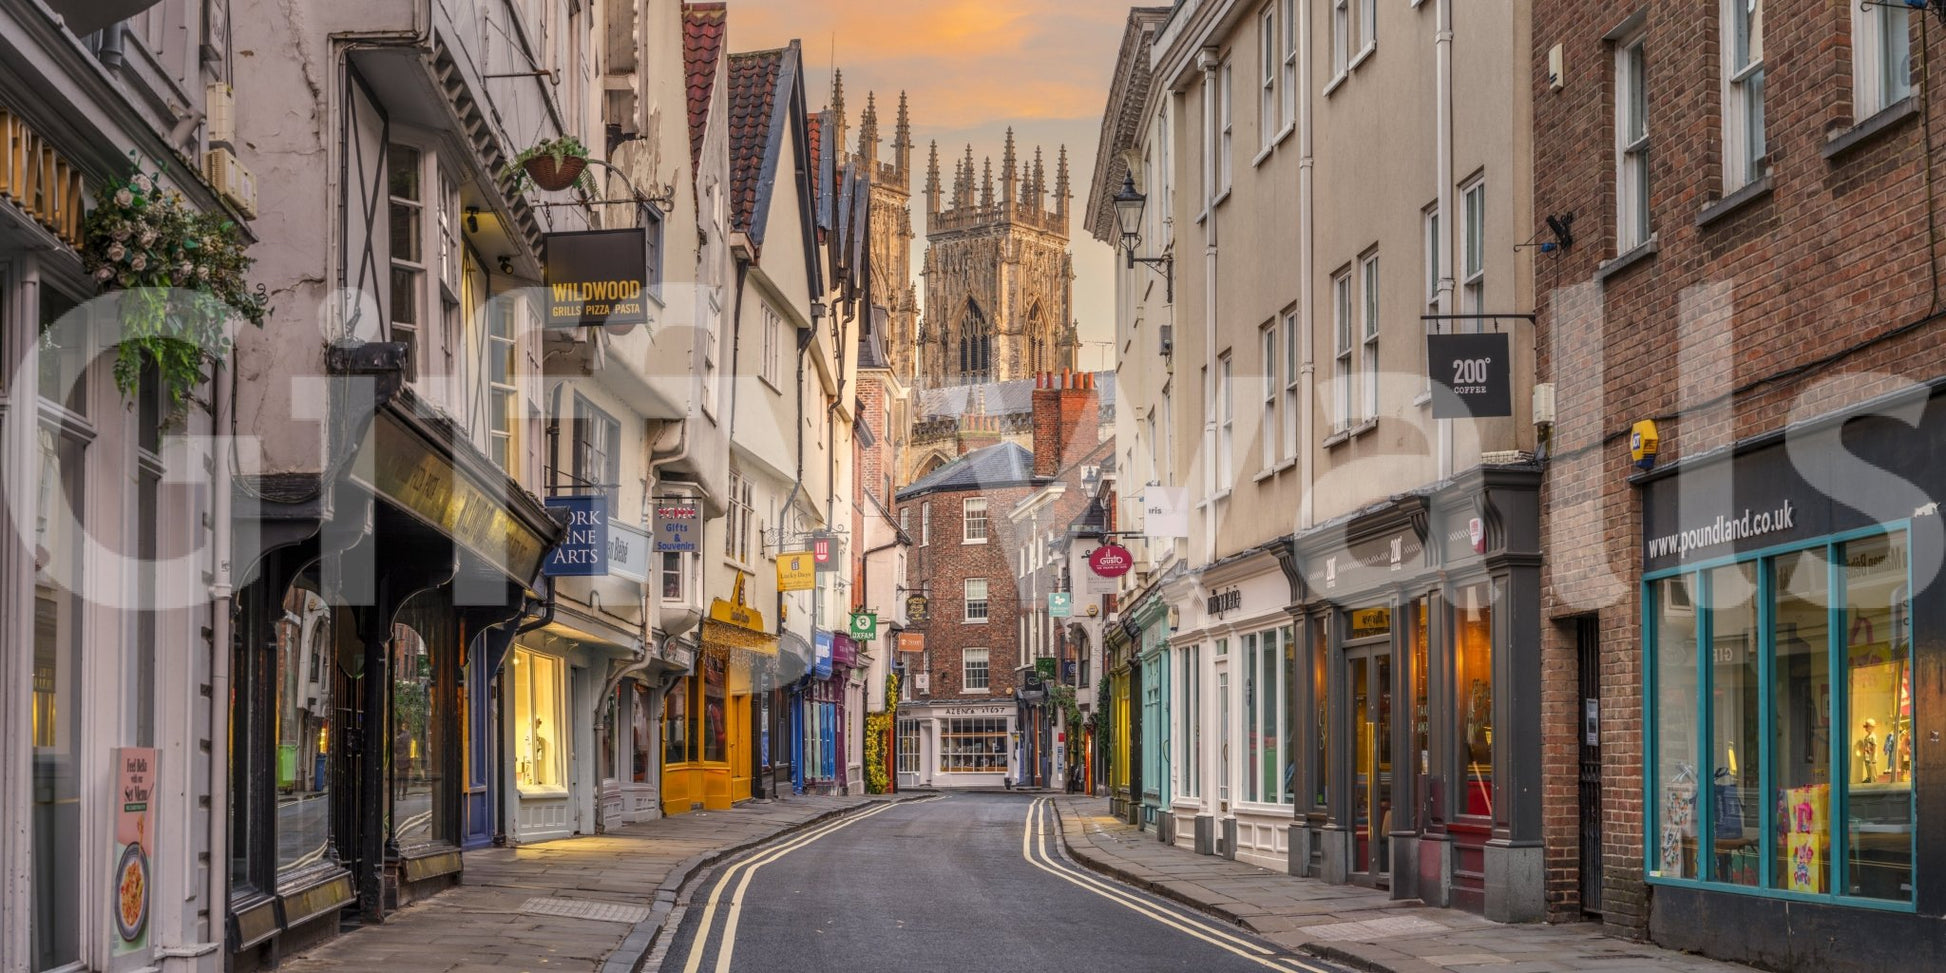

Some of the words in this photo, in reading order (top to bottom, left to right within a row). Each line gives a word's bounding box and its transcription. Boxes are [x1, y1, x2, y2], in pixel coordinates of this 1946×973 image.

[552, 280, 641, 303] WILDWOOD
[552, 305, 582, 317] GRILLS
[585, 304, 610, 316] PIZZA
[614, 303, 641, 314] PASTA
[1454, 386, 1487, 394] COFFEE
[665, 522, 688, 532] Gifts
[1648, 499, 1794, 559] www.poundland.co.uk
[564, 529, 597, 545] INE
[673, 533, 681, 542] &
[657, 541, 696, 551] Souvenirs
[552, 548, 599, 565] ARTS
[852, 632, 875, 640] OXFAM
[135, 785, 148, 801] Menu
